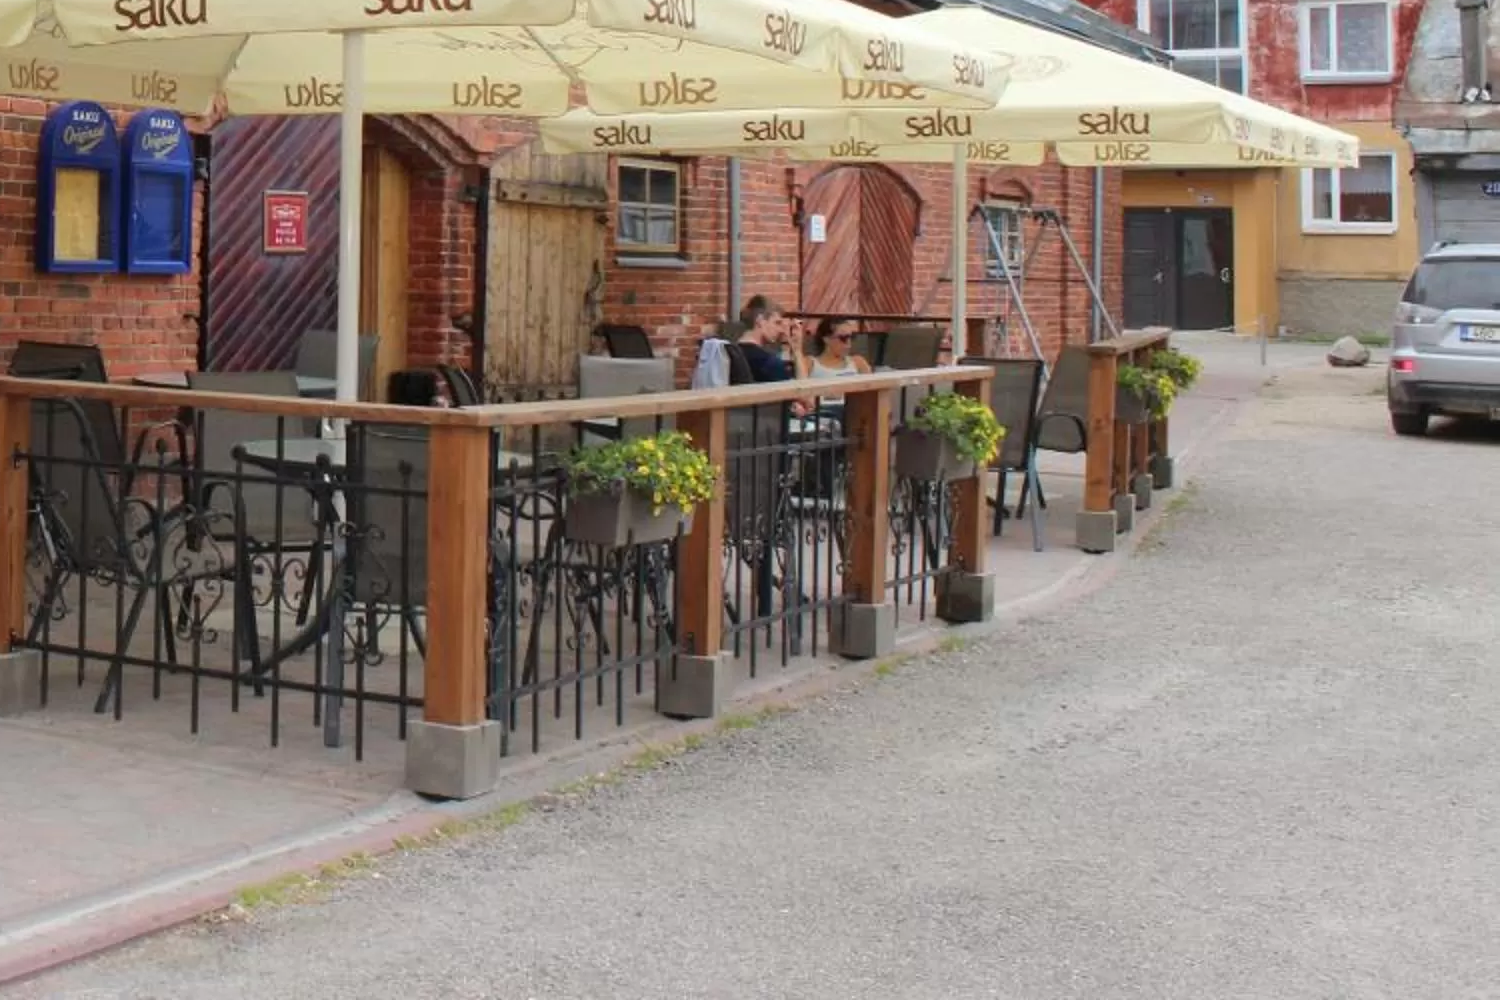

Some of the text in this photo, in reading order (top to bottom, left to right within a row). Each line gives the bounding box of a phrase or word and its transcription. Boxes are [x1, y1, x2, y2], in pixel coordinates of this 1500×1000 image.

[763, 10, 807, 56] saku
[863, 37, 904, 73] saku
[594, 120, 651, 147] saku
[743, 114, 805, 142] saku
[906, 107, 972, 138] saku
[1077, 106, 1150, 136] saku
